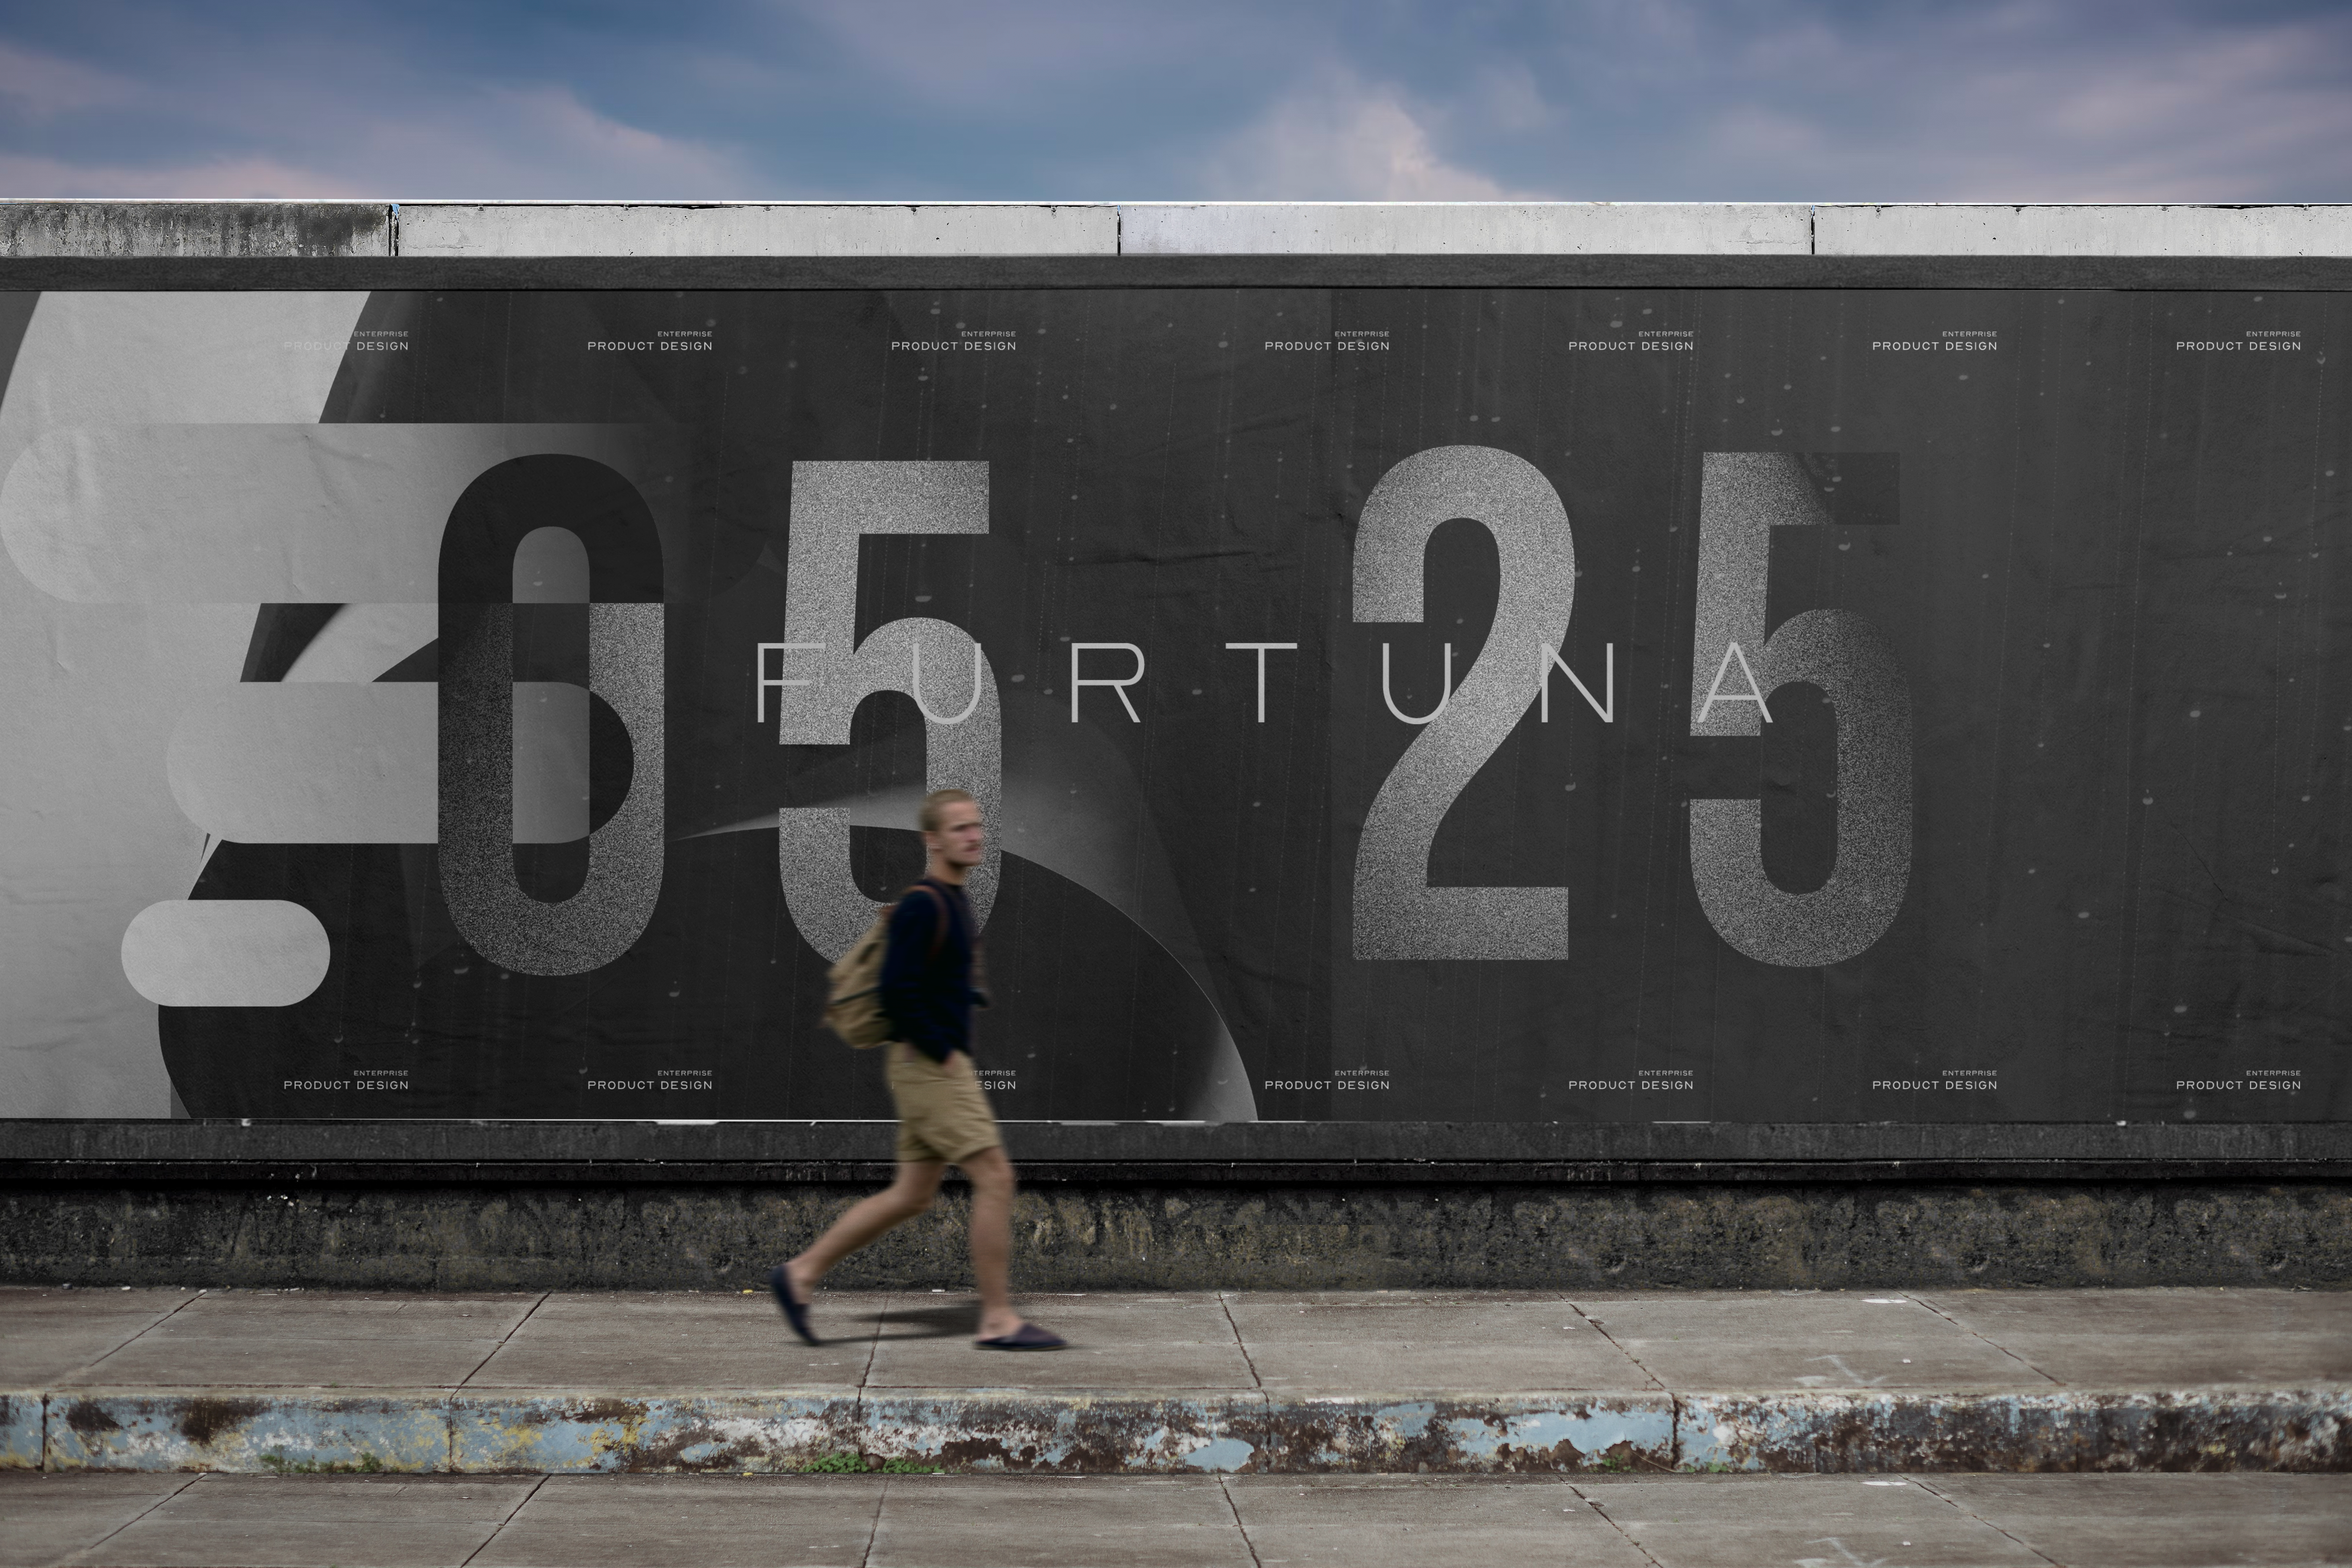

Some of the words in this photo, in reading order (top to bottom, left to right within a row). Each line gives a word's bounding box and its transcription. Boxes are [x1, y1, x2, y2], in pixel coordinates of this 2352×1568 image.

[284, 341, 350, 350] PRODUCT
[357, 341, 408, 350] DESIGN
[588, 341, 654, 350] PRODUCT
[661, 341, 712, 350] DESIGN
[892, 341, 958, 350] PRODUCT
[965, 341, 1016, 350] DESIGN
[1265, 341, 1331, 350] PRODUCT
[1338, 341, 1389, 350] DESIGN
[1569, 341, 1635, 350] PRODUCT
[1642, 341, 1693, 350] DESIGN
[1873, 341, 1939, 350] PRODUCT
[1945, 341, 1996, 350] DESIGN
[2176, 341, 2243, 350] PRODUCT
[2249, 341, 2300, 350] DESIGN
[757, 642, 1773, 725] FURTUNA
[284, 1080, 350, 1089] PRODUCT
[357, 1080, 408, 1089] DESIGN
[588, 1080, 654, 1089] PRODUCT
[661, 1080, 712, 1089] DESIGN
[975, 1080, 1016, 1089] ESIGN
[1265, 1080, 1331, 1089] PRODUCT
[1338, 1080, 1389, 1089] DESIGN
[1569, 1080, 1635, 1089] PRODUCT
[1642, 1080, 1693, 1089] DESIGN
[1873, 1080, 1939, 1089] PRODUCT
[1945, 1080, 1996, 1089] DESIGN
[2176, 1080, 2243, 1089] PRODUCT
[2249, 1080, 2300, 1089] DESIGN
